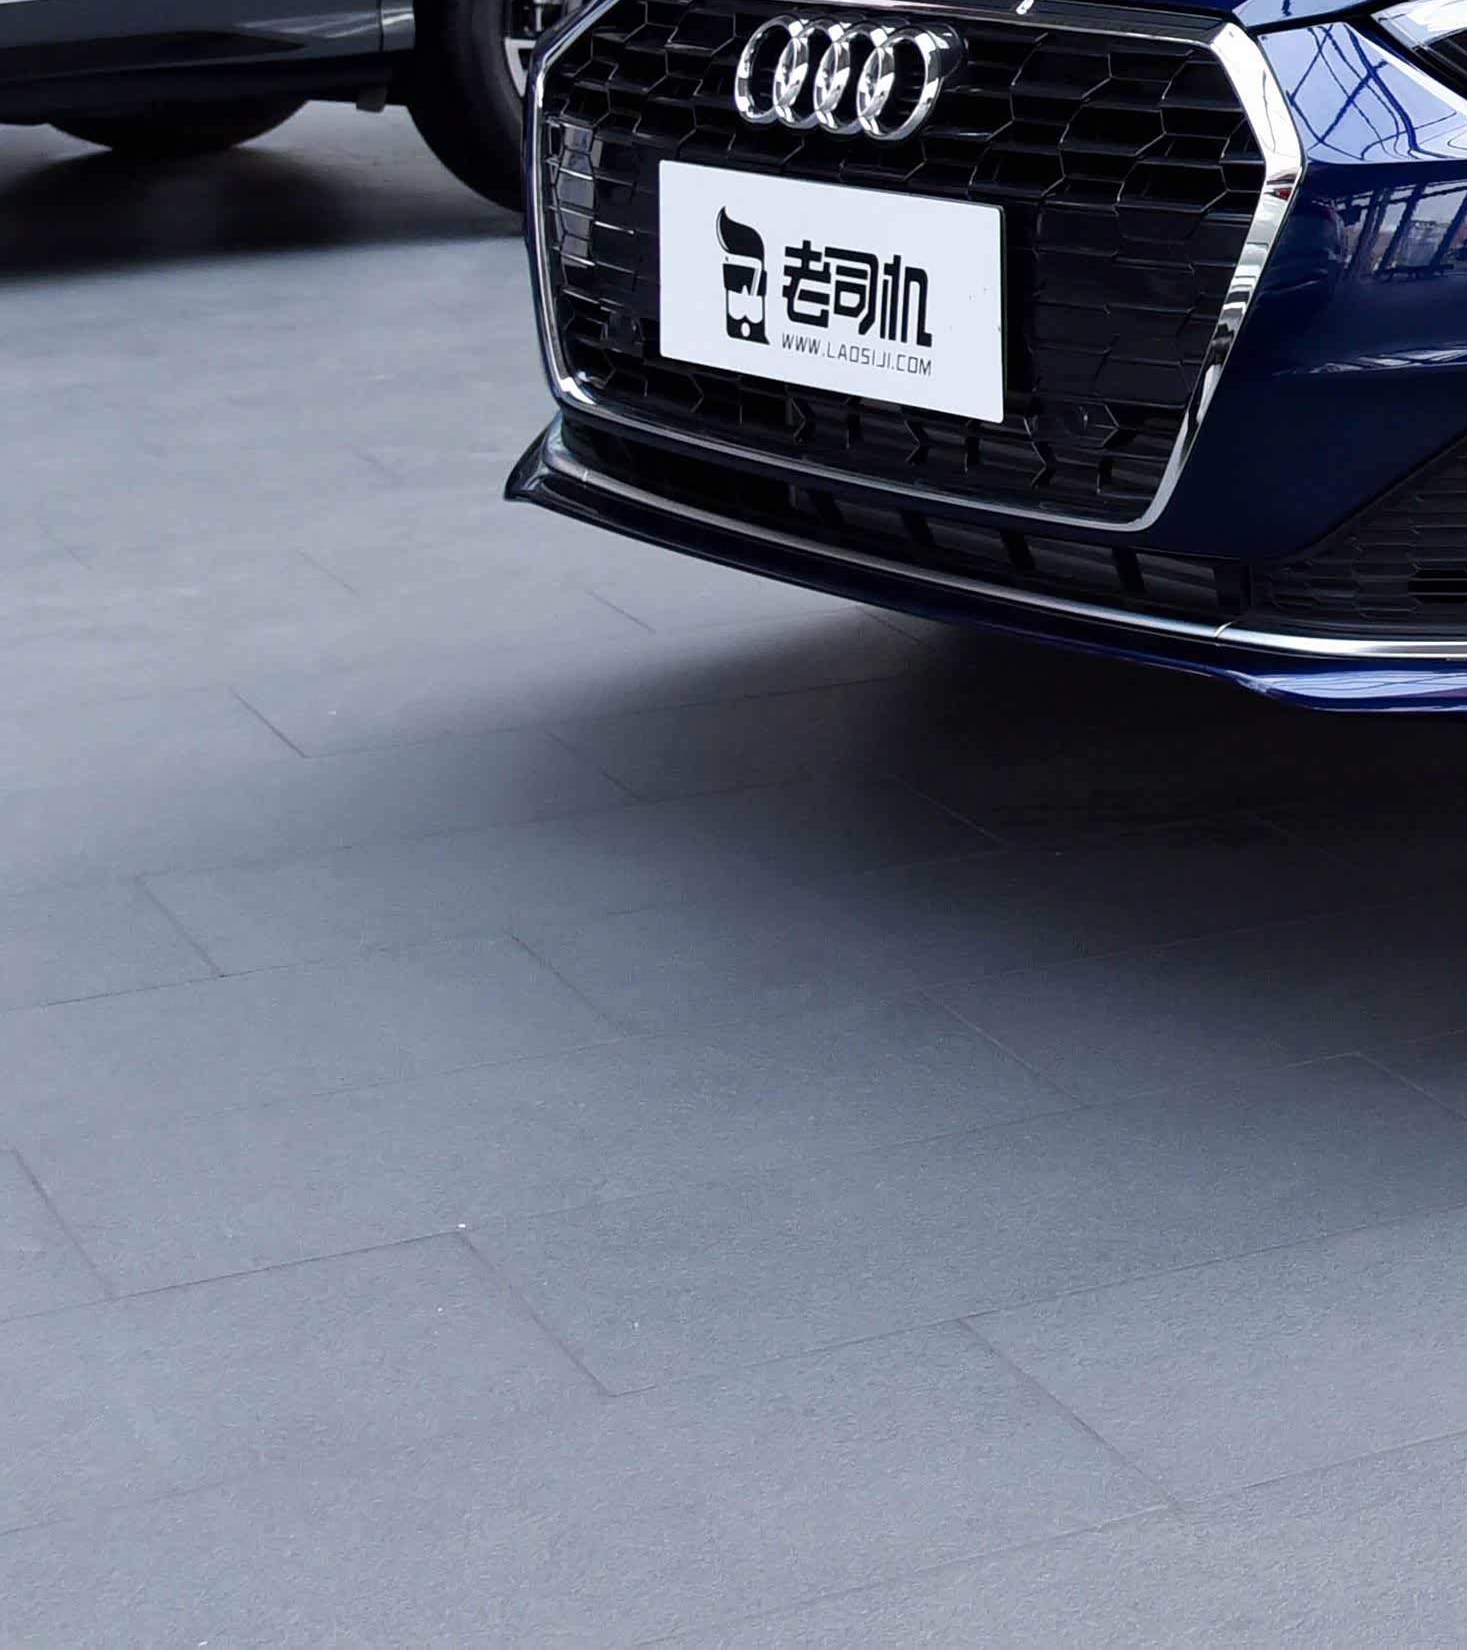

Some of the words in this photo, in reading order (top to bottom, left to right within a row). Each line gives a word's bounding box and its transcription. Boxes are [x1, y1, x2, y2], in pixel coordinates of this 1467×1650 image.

[782, 239, 933, 348] 老司机
[781, 332, 933, 377] WWW.LAOSIJI.COM
